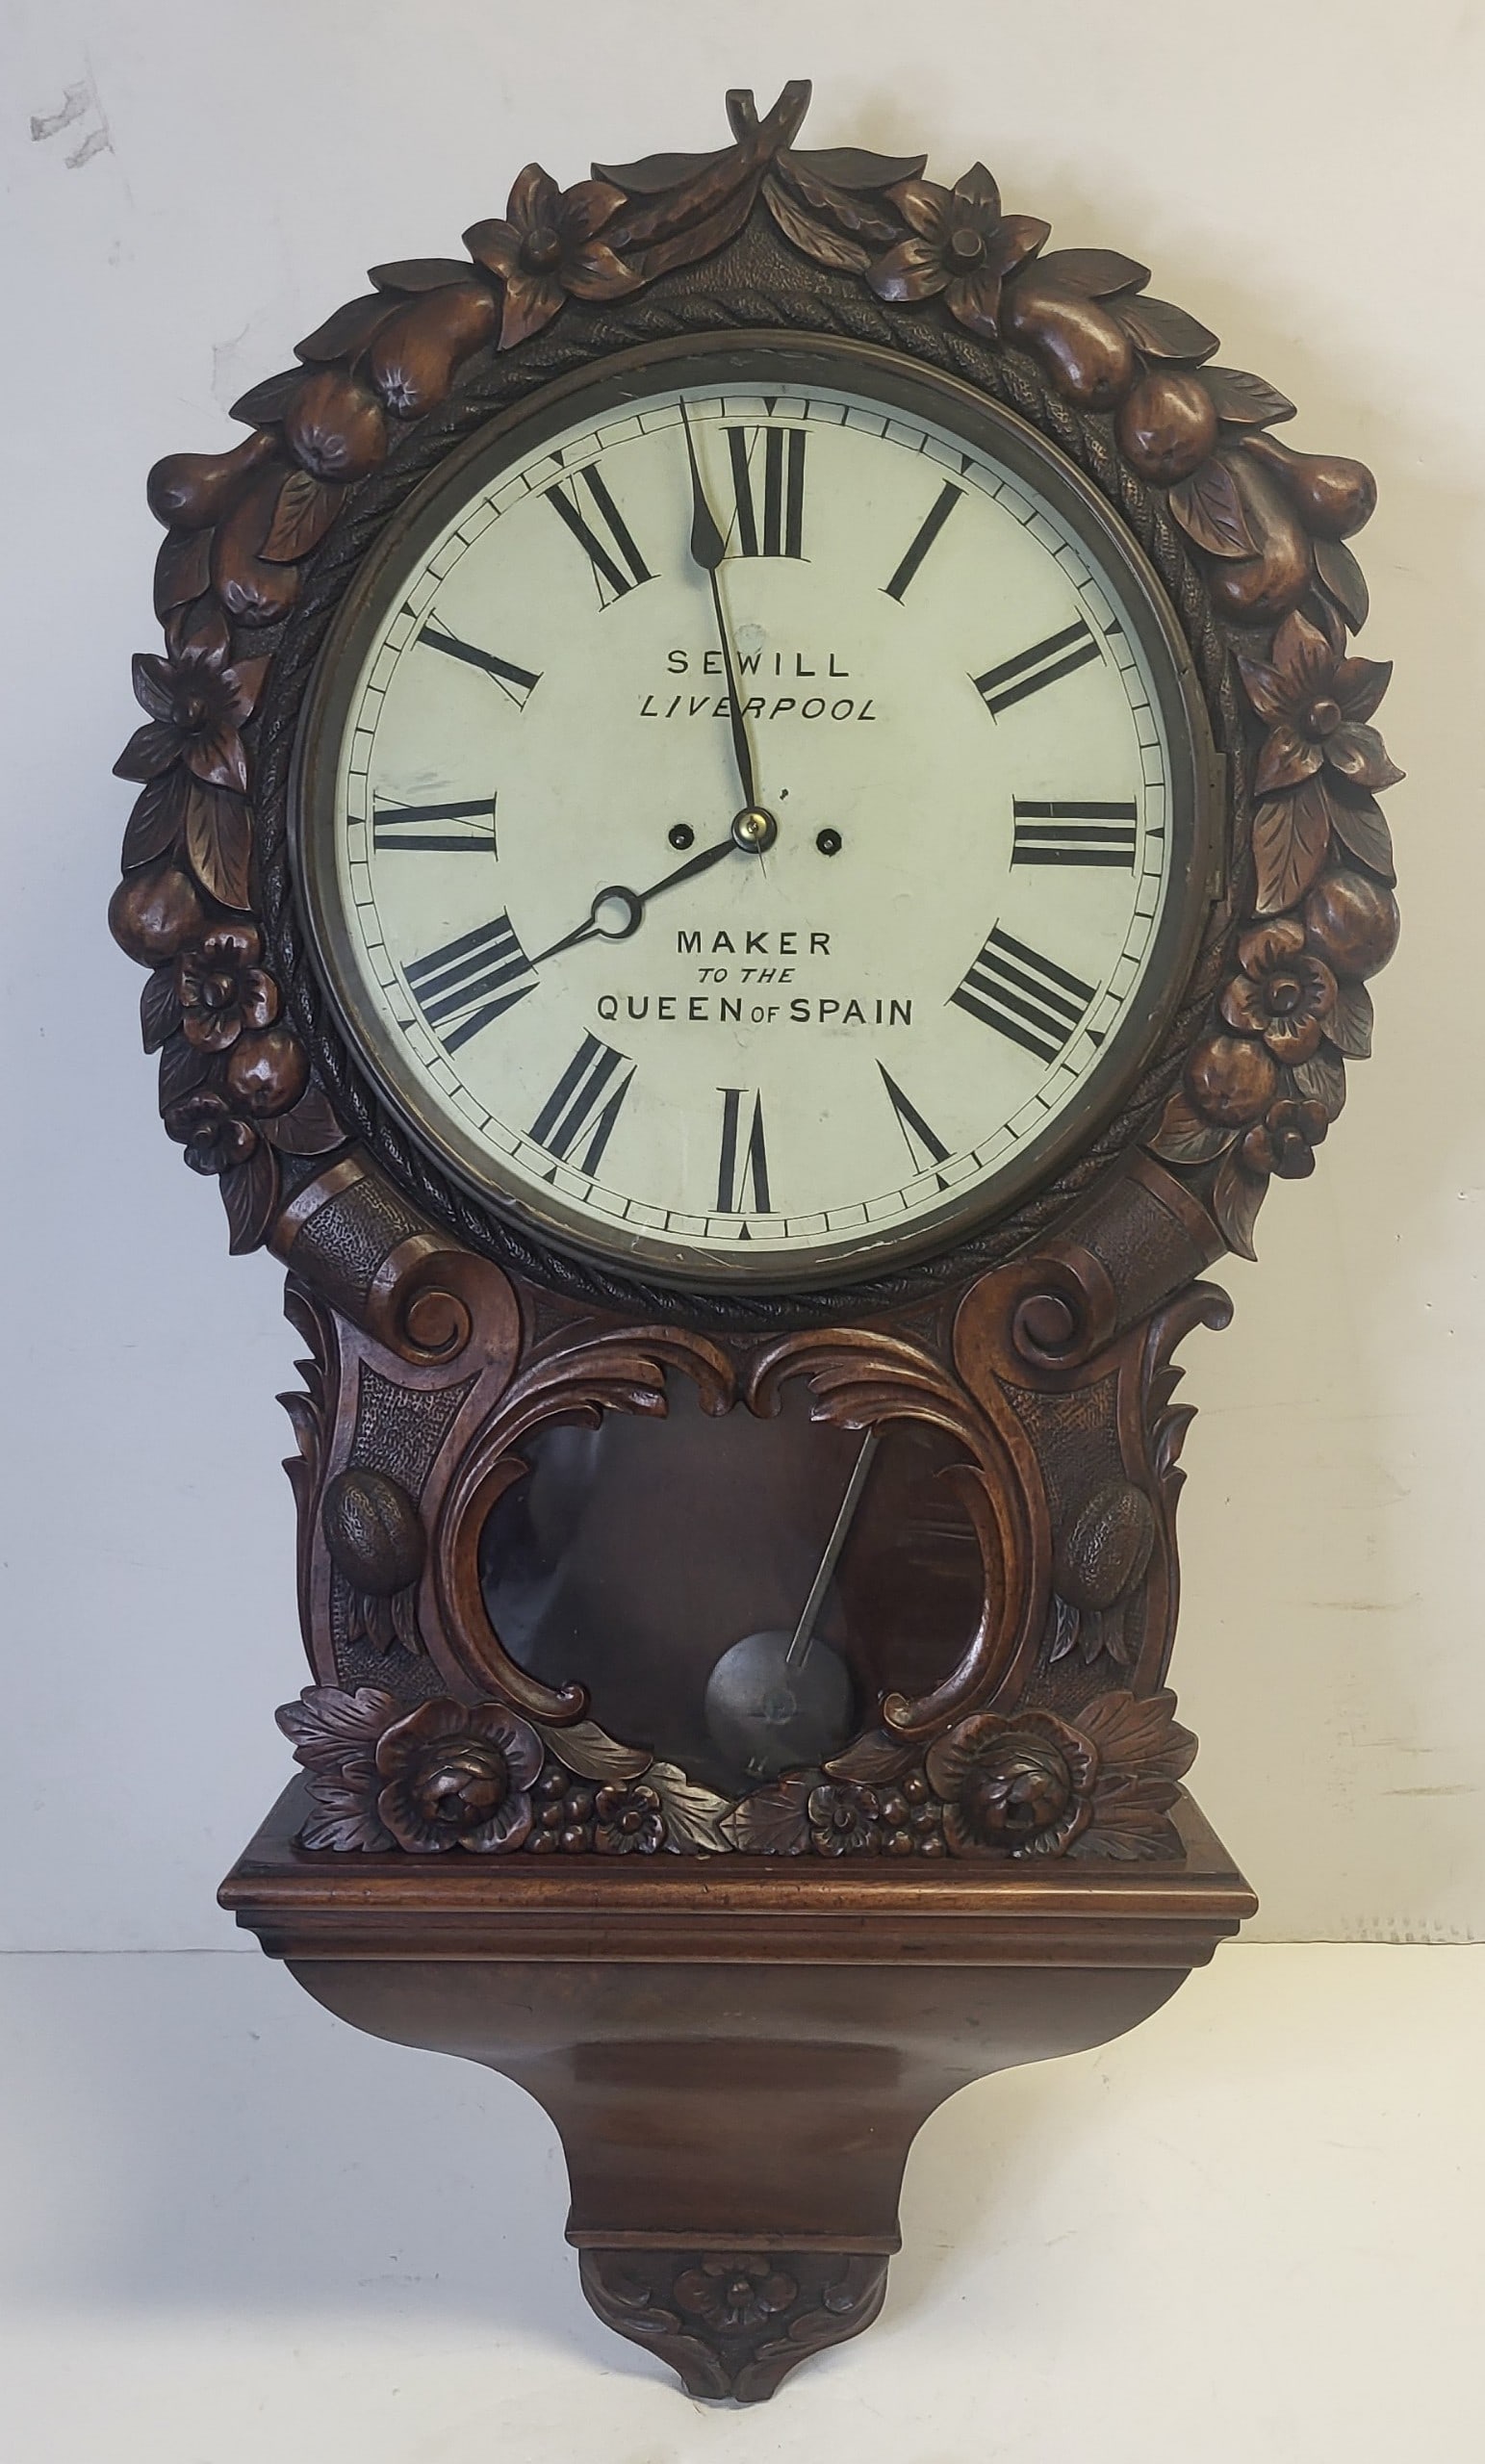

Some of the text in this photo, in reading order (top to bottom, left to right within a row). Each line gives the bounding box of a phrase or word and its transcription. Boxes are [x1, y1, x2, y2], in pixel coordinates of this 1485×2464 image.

[537, 460, 661, 612] XI
[719, 425, 814, 562] XII
[878, 478, 969, 606] I
[411, 607, 544, 712] X
[639, 695, 877, 720] LIVERPOOL
[667, 650, 849, 678] SEWILL
[966, 605, 1107, 725] II
[373, 790, 498, 861] IX
[1010, 794, 1136, 877] III
[400, 906, 540, 1060] VIII
[678, 931, 831, 956] MAKER
[698, 968, 796, 983] TO THE
[943, 917, 1101, 1071] IIII
[598, 995, 912, 1025] QUEEN OF SPAIN
[521, 1027, 637, 1181] VII
[708, 1087, 780, 1214] VI
[875, 1058, 957, 1176] V
